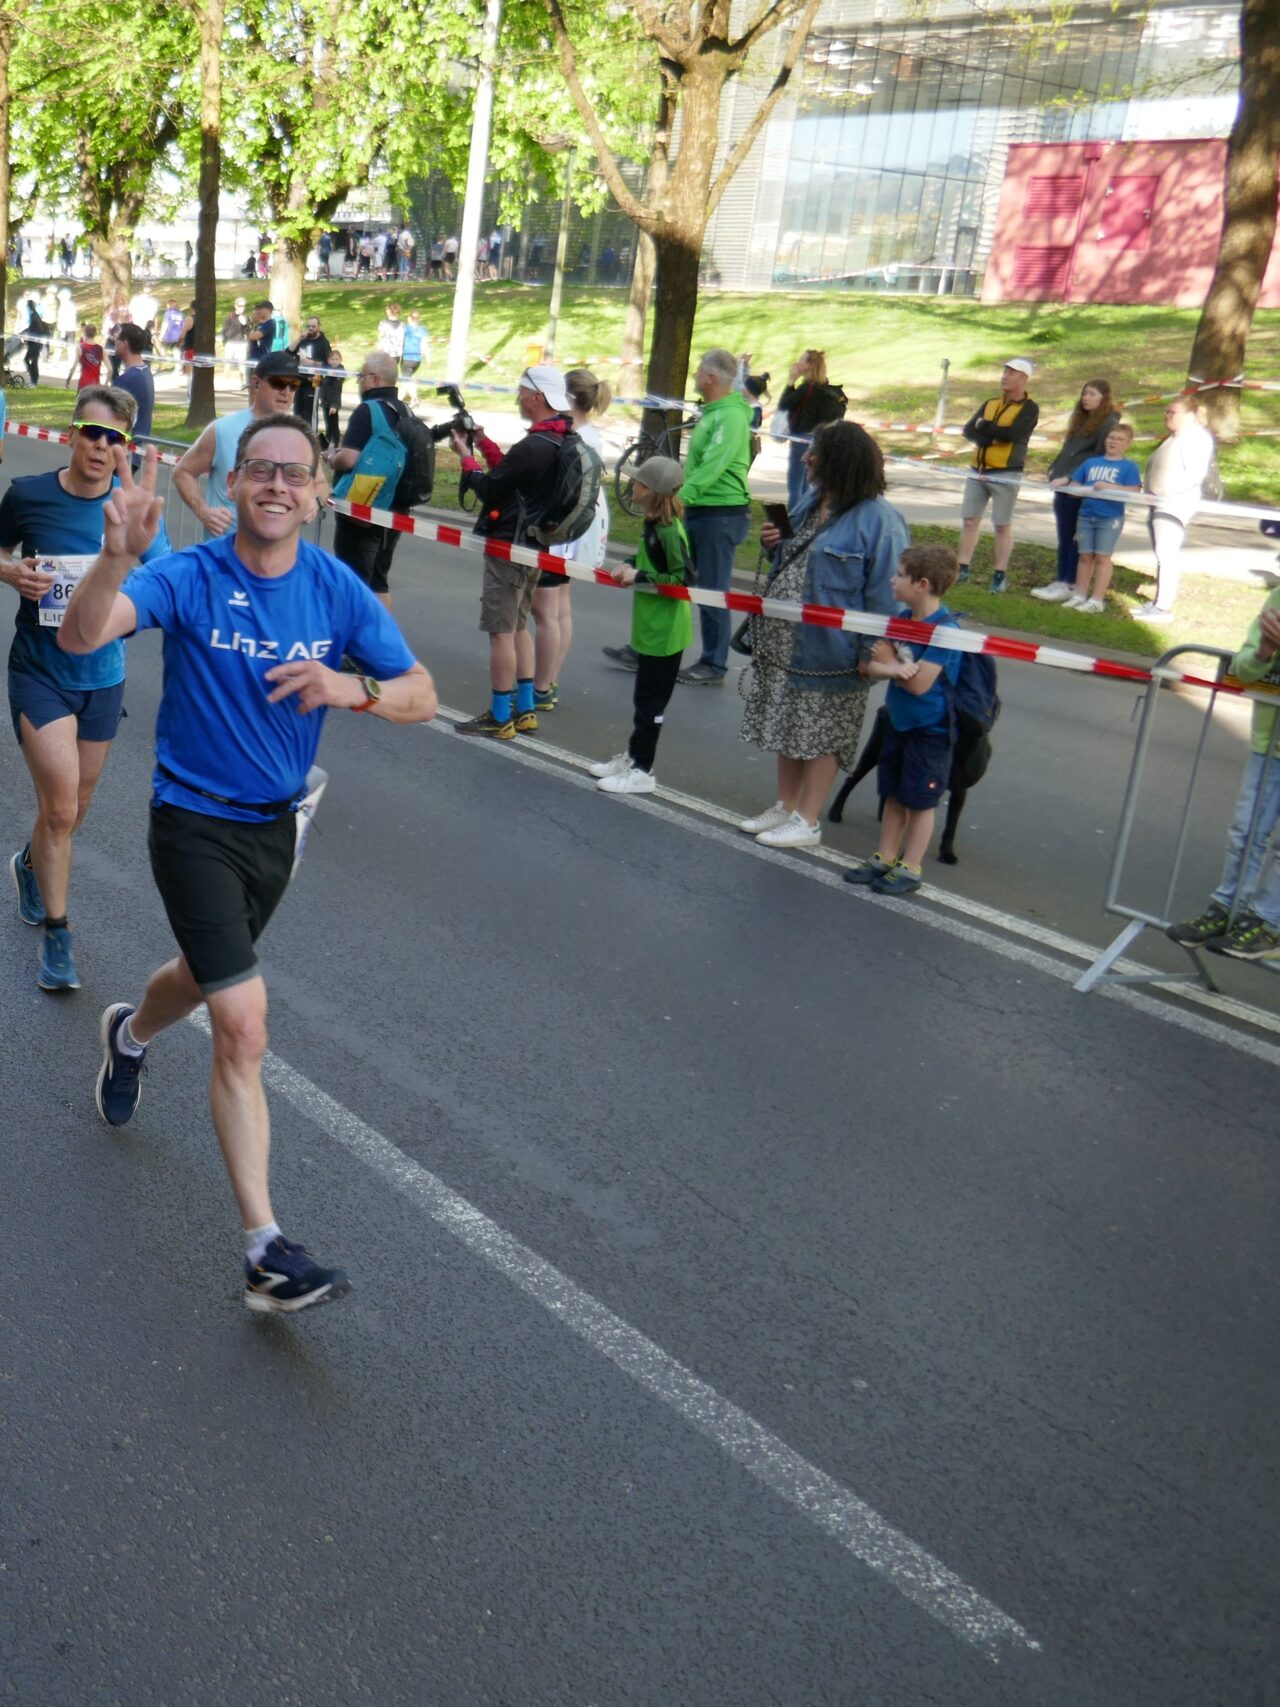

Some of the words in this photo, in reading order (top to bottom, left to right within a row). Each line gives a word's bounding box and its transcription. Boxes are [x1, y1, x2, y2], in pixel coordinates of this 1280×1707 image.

[1088, 466, 1120, 483] NIKE
[53, 583, 75, 600] 86
[285, 640, 333, 661] AG
